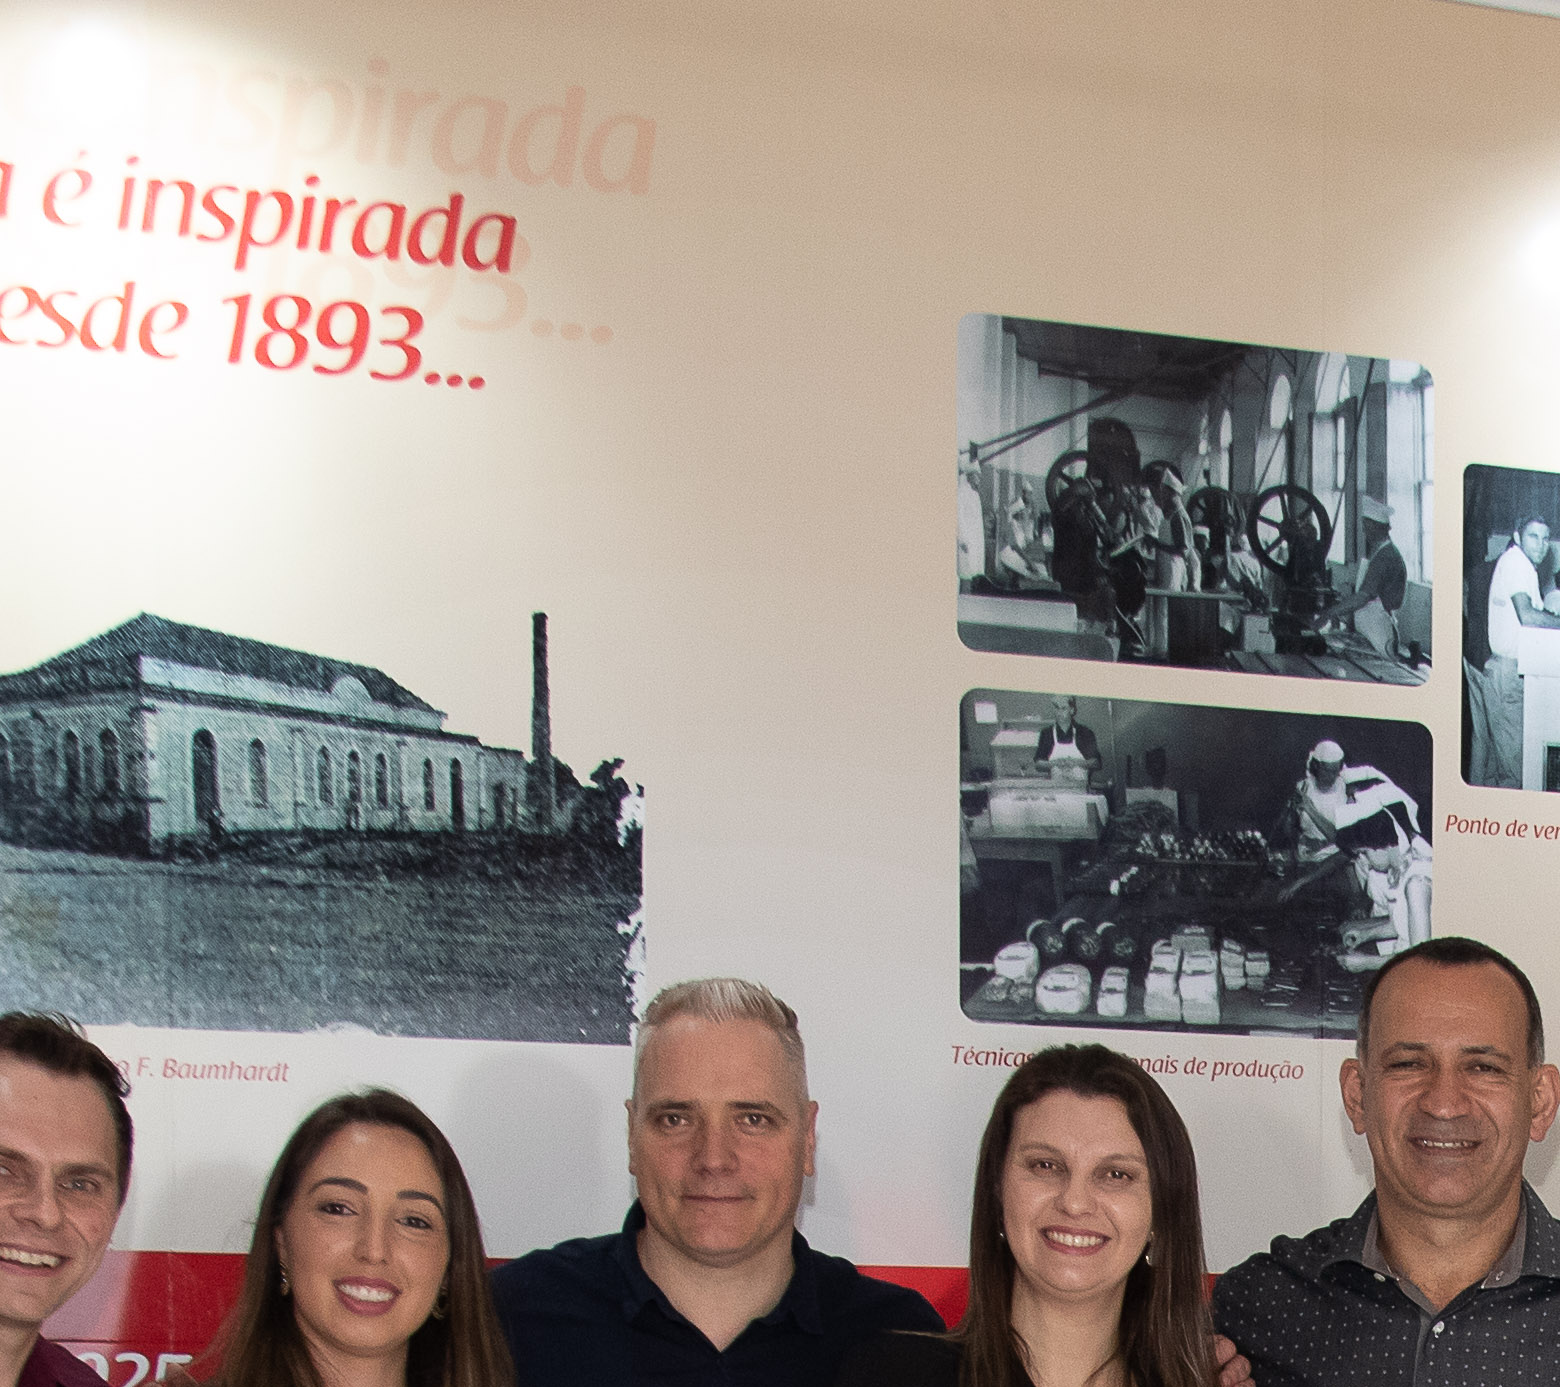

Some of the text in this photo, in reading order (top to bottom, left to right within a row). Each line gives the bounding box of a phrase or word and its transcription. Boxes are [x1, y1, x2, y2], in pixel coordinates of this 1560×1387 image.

[43, 149, 93, 228] é
[117, 156, 518, 275] inspirada
[224, 291, 486, 391] 1893...
[1445, 814, 1500, 836] Ponto
[1505, 820, 1528, 838] de
[137, 1057, 154, 1077] F.
[162, 1058, 289, 1082] Baumhardt
[1183, 1056, 1206, 1075] de
[1211, 1059, 1304, 1083] produção
